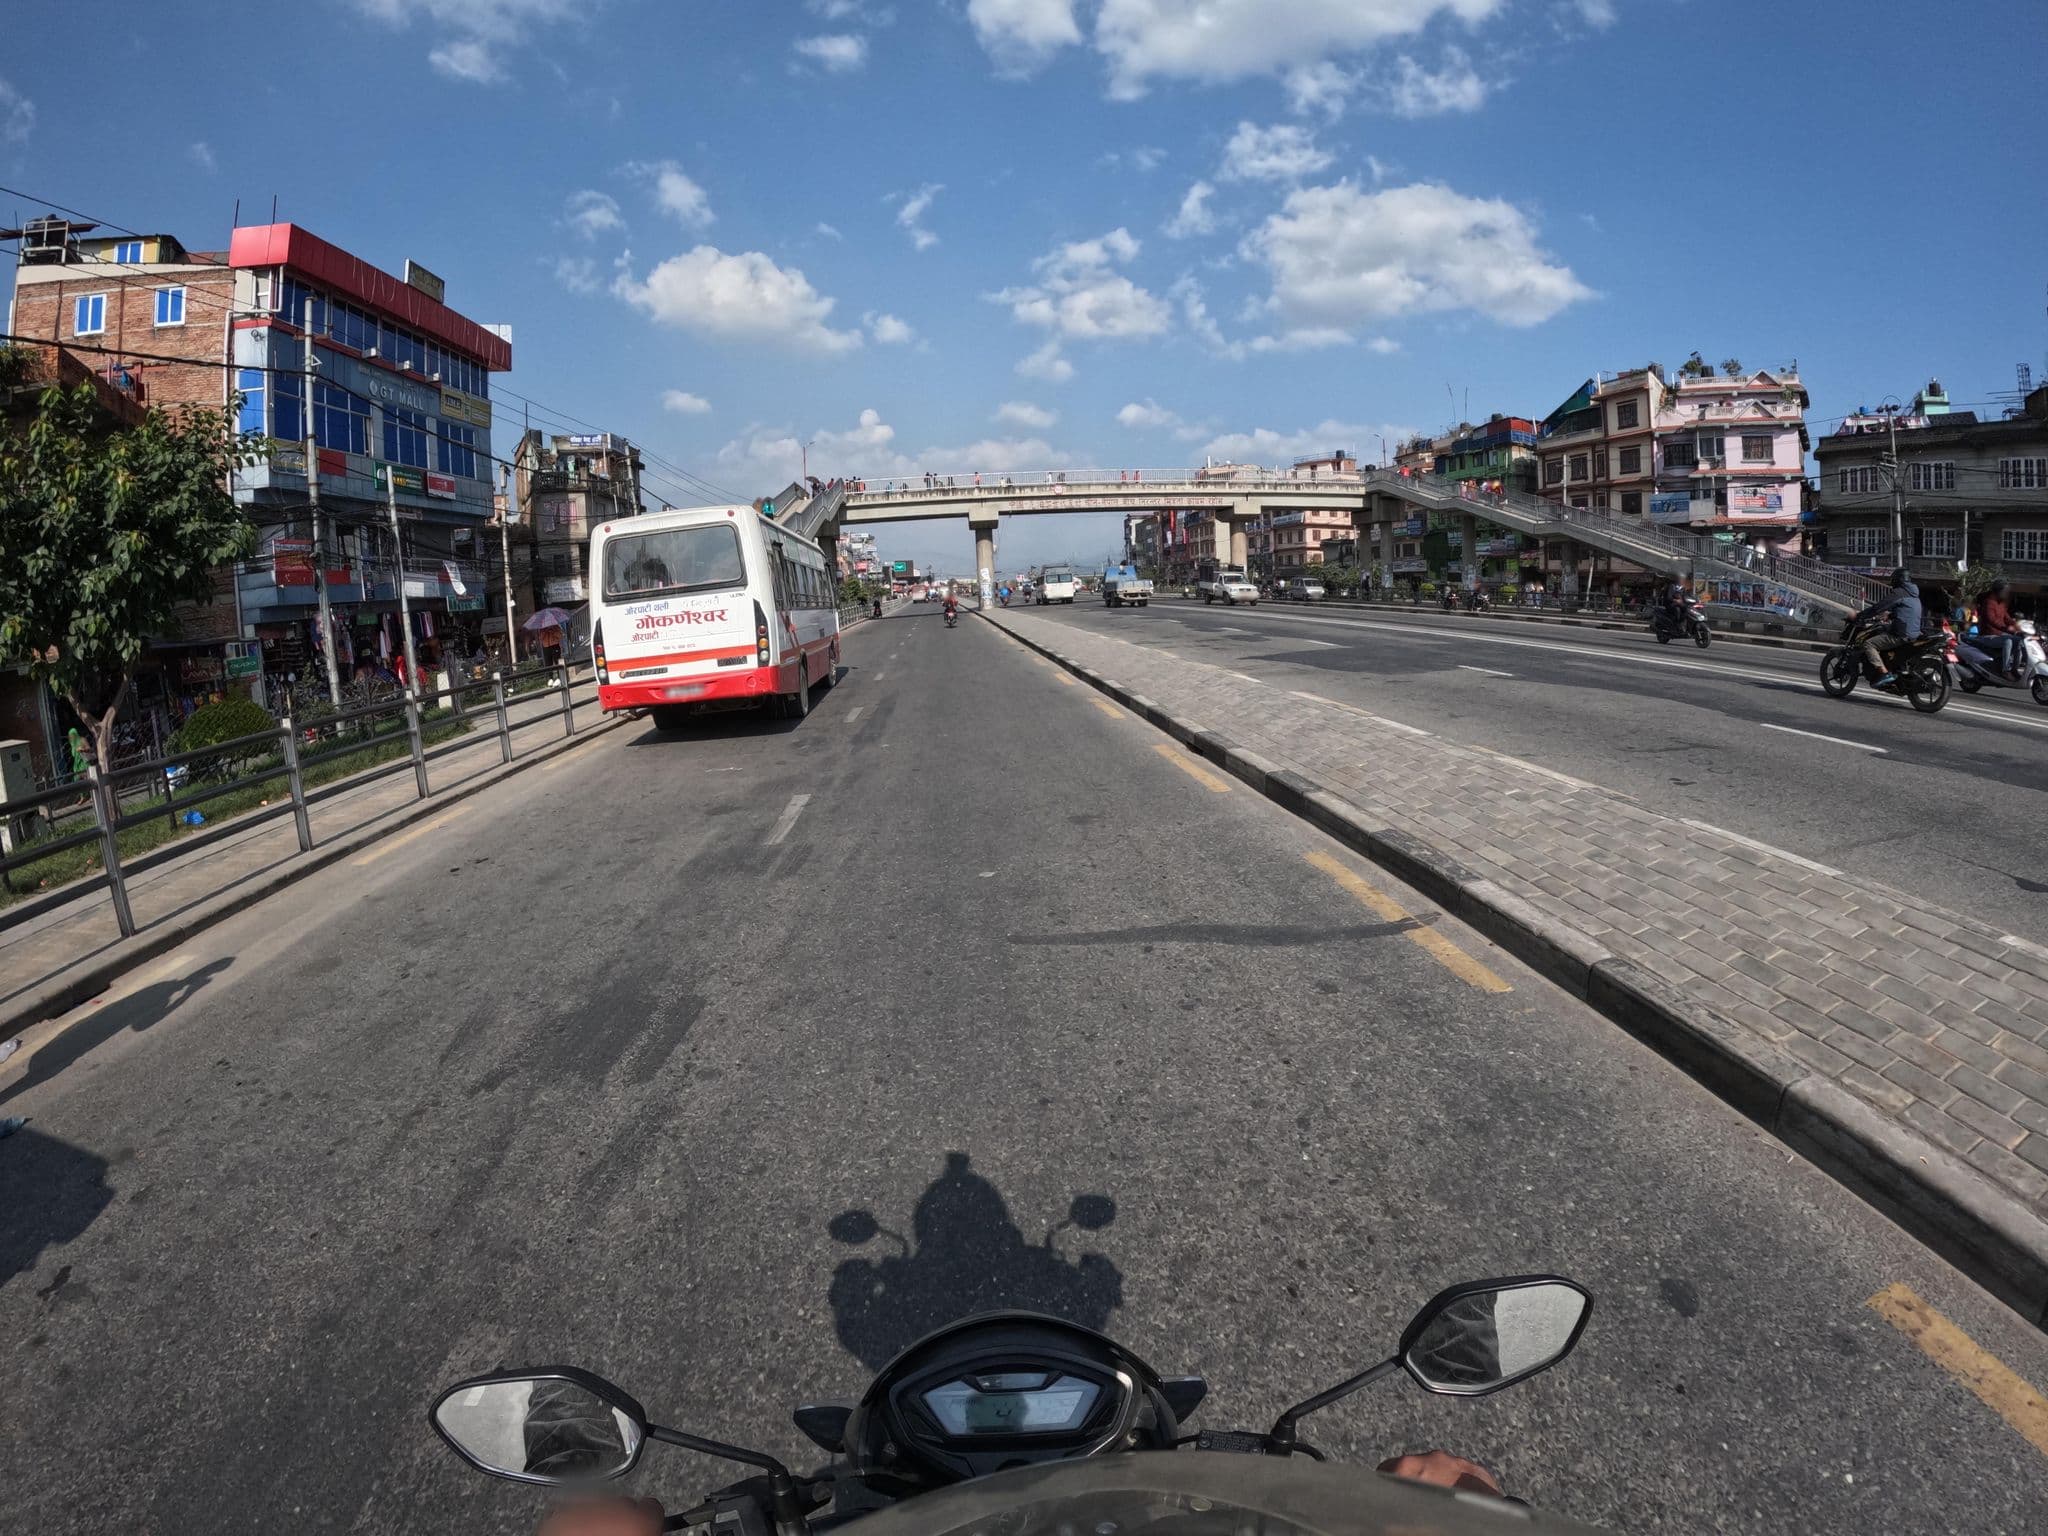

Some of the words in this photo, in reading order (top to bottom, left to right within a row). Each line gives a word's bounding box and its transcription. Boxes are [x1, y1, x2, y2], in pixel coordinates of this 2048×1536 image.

[380, 386, 394, 400] GT
[399, 391, 424, 411] MALL
[635, 608, 729, 630] गोकर्णेश्वर
